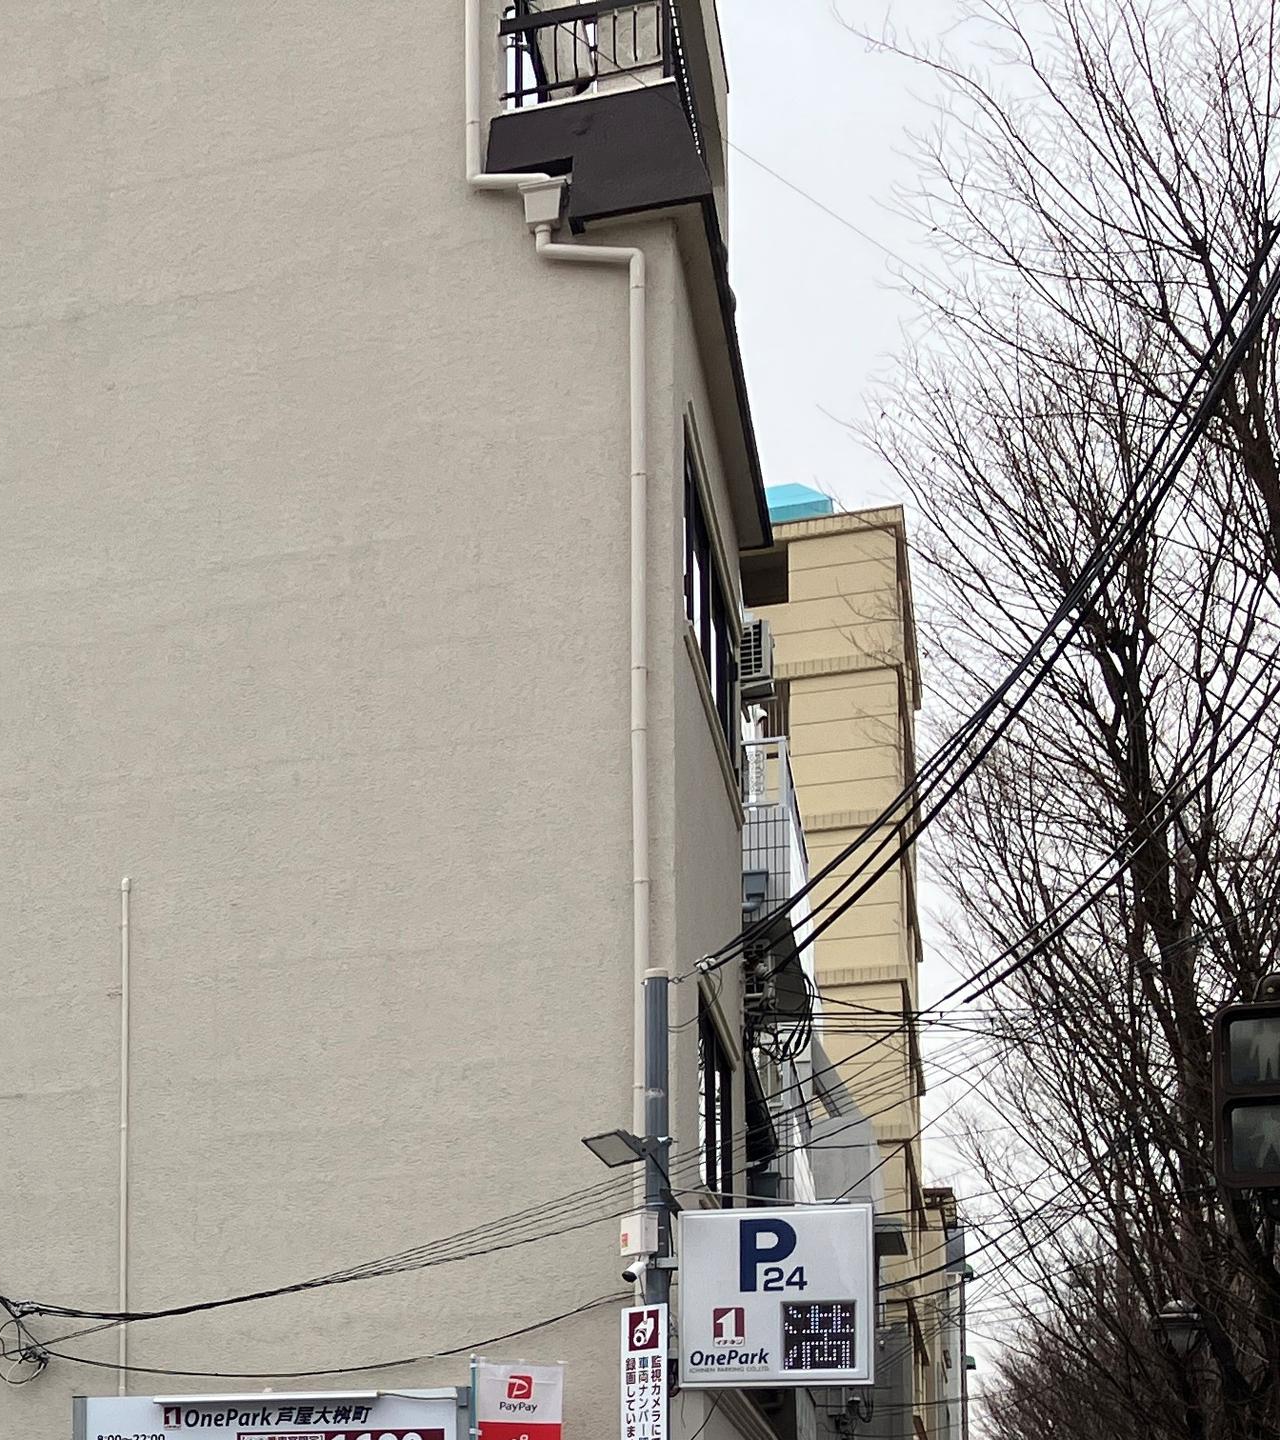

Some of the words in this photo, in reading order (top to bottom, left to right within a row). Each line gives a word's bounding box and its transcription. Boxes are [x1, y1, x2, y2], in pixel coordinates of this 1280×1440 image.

[739, 1218, 797, 1292] P
[763, 1266, 808, 1291] 24
[784, 1304, 855, 1370] 満
[690, 1347, 770, 1366] OnePark
[184, 1407, 272, 1428] OnePark
[499, 1402, 538, 1412] PayPay
